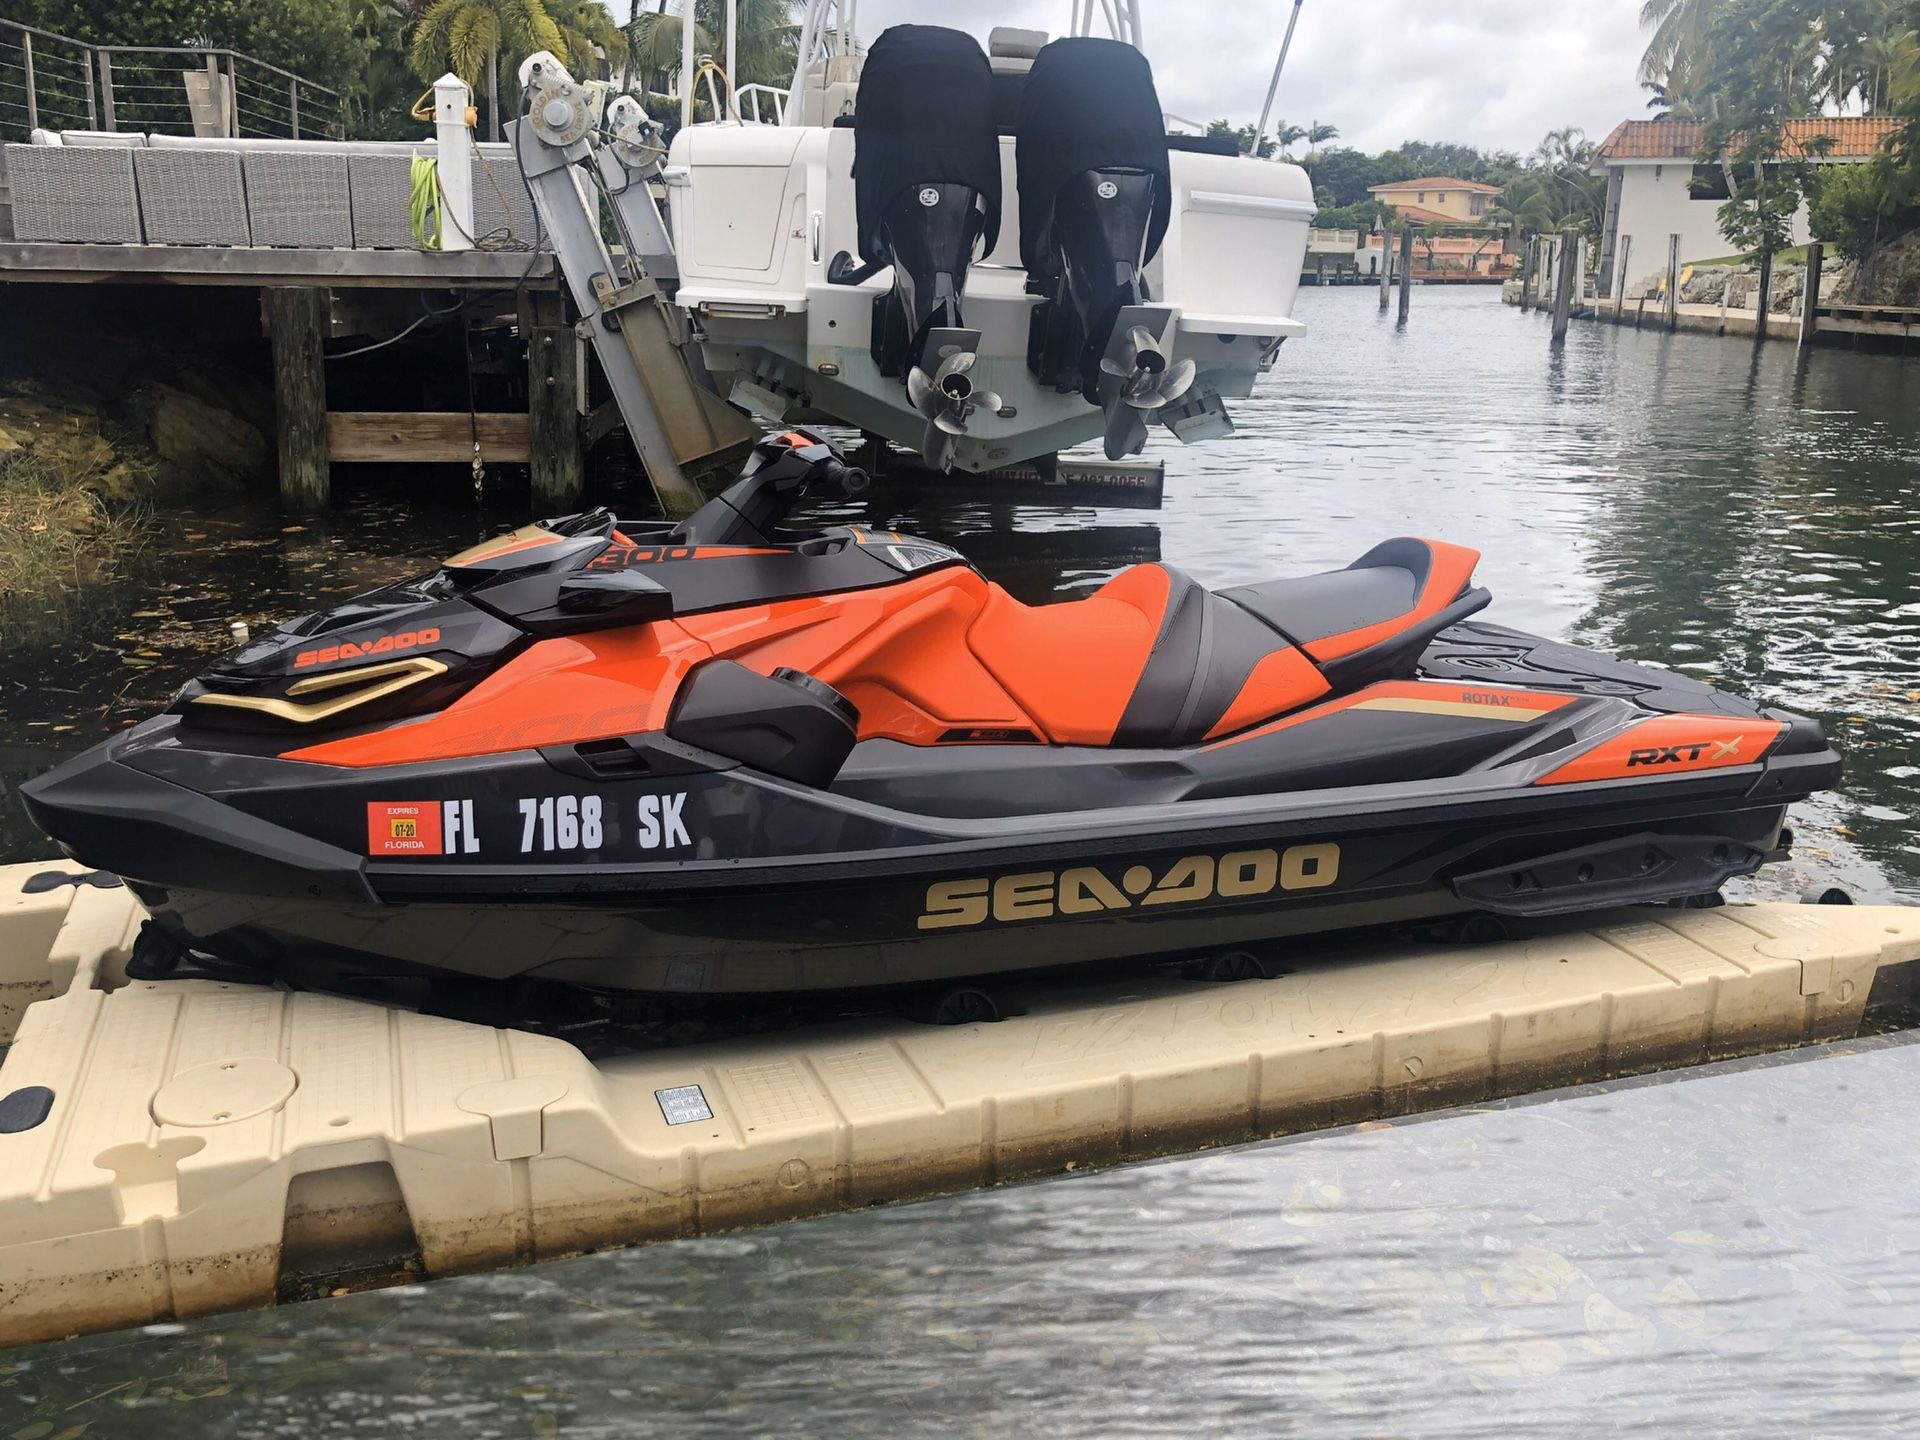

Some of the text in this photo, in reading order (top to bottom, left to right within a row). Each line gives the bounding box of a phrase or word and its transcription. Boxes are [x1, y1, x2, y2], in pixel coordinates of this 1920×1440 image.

[591, 545, 697, 569] 300
[1462, 692, 1510, 707] ROTAX
[387, 807, 419, 815] EXPIRES
[395, 824, 415, 837] 07-20
[444, 792, 692, 855] FL 7168 SK
[384, 841, 425, 849] FLORIDA
